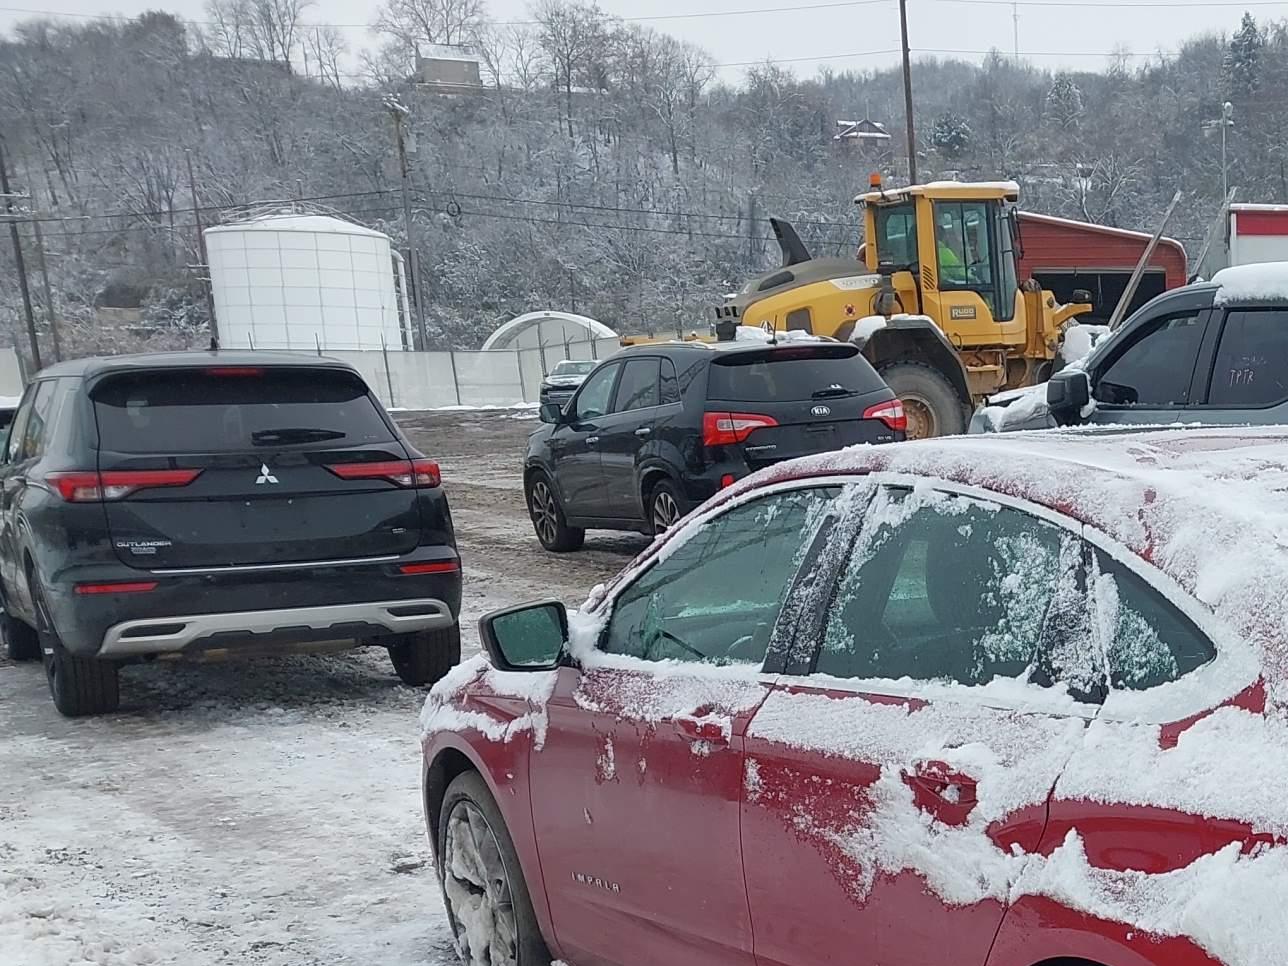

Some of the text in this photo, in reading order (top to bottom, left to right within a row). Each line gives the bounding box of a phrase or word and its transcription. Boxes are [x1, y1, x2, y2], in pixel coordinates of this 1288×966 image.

[813, 406, 829, 416] KIA
[116, 540, 172, 548] OUTLANDER
[571, 871, 621, 893] IMPALA
